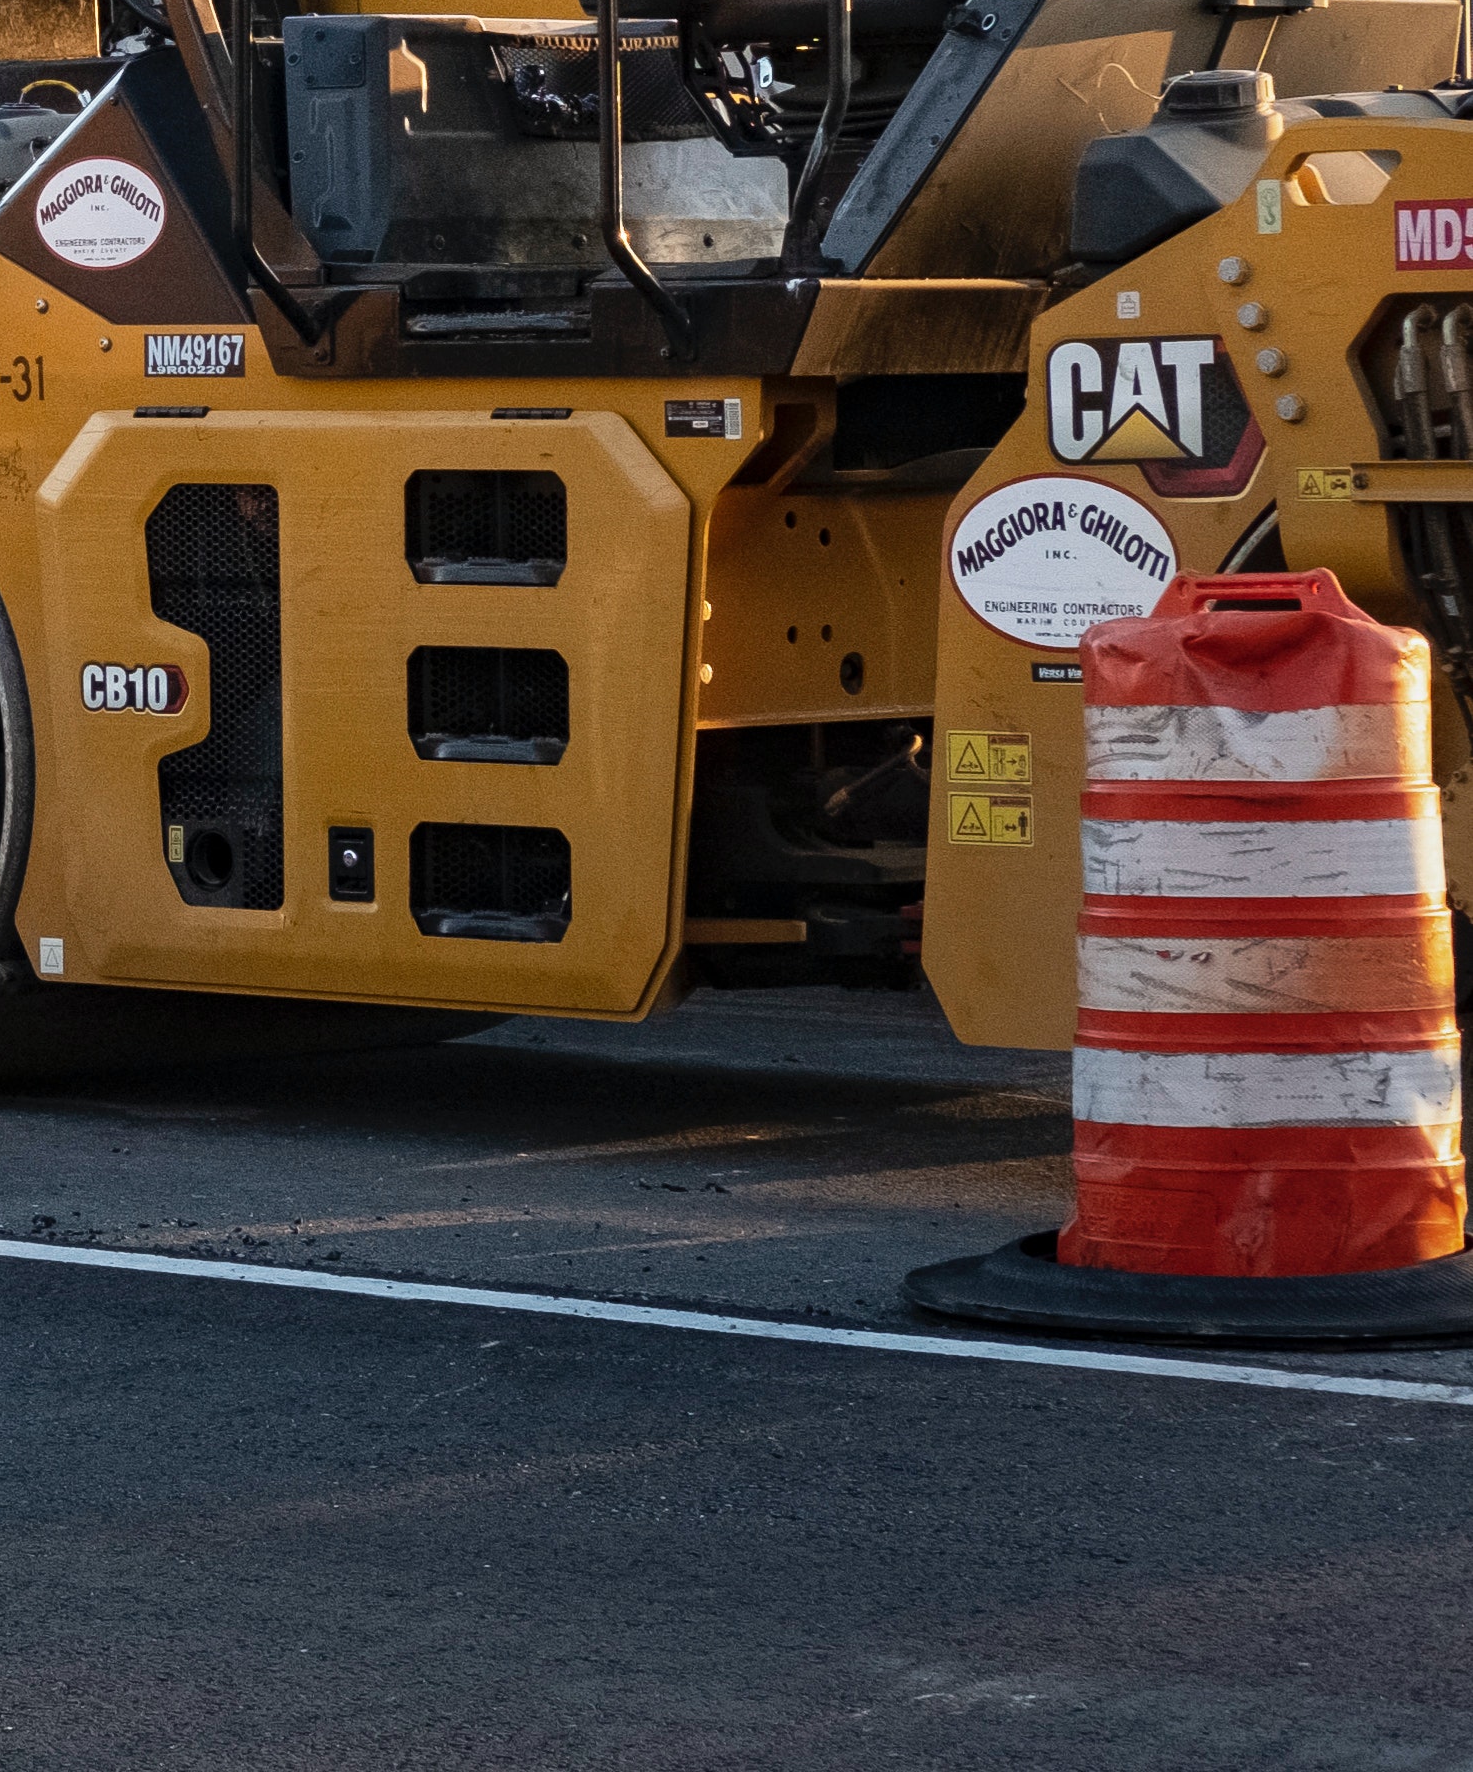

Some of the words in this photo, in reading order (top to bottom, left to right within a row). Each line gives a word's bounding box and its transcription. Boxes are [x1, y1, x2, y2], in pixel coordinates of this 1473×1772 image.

[39, 174, 103, 226] MAGGIORA
[110, 174, 161, 223] GHILOTTI
[90, 204, 110, 212] INC.
[55, 238, 98, 247] ENGINEERING
[100, 237, 146, 247] CONTRACTORS
[147, 334, 244, 366] NM49167
[147, 365, 226, 375] L9R00220
[1049, 339, 1215, 461] CAT
[956, 501, 1067, 577] MAGGIORA
[1068, 503, 1078, 518] &
[1080, 504, 1170, 582] GHILOTTI
[1045, 550, 1077, 560] INC.
[984, 600, 1058, 615] ENGINEERING
[1063, 602, 1143, 616] CONTRACTORS
[82, 664, 168, 711] CB10
